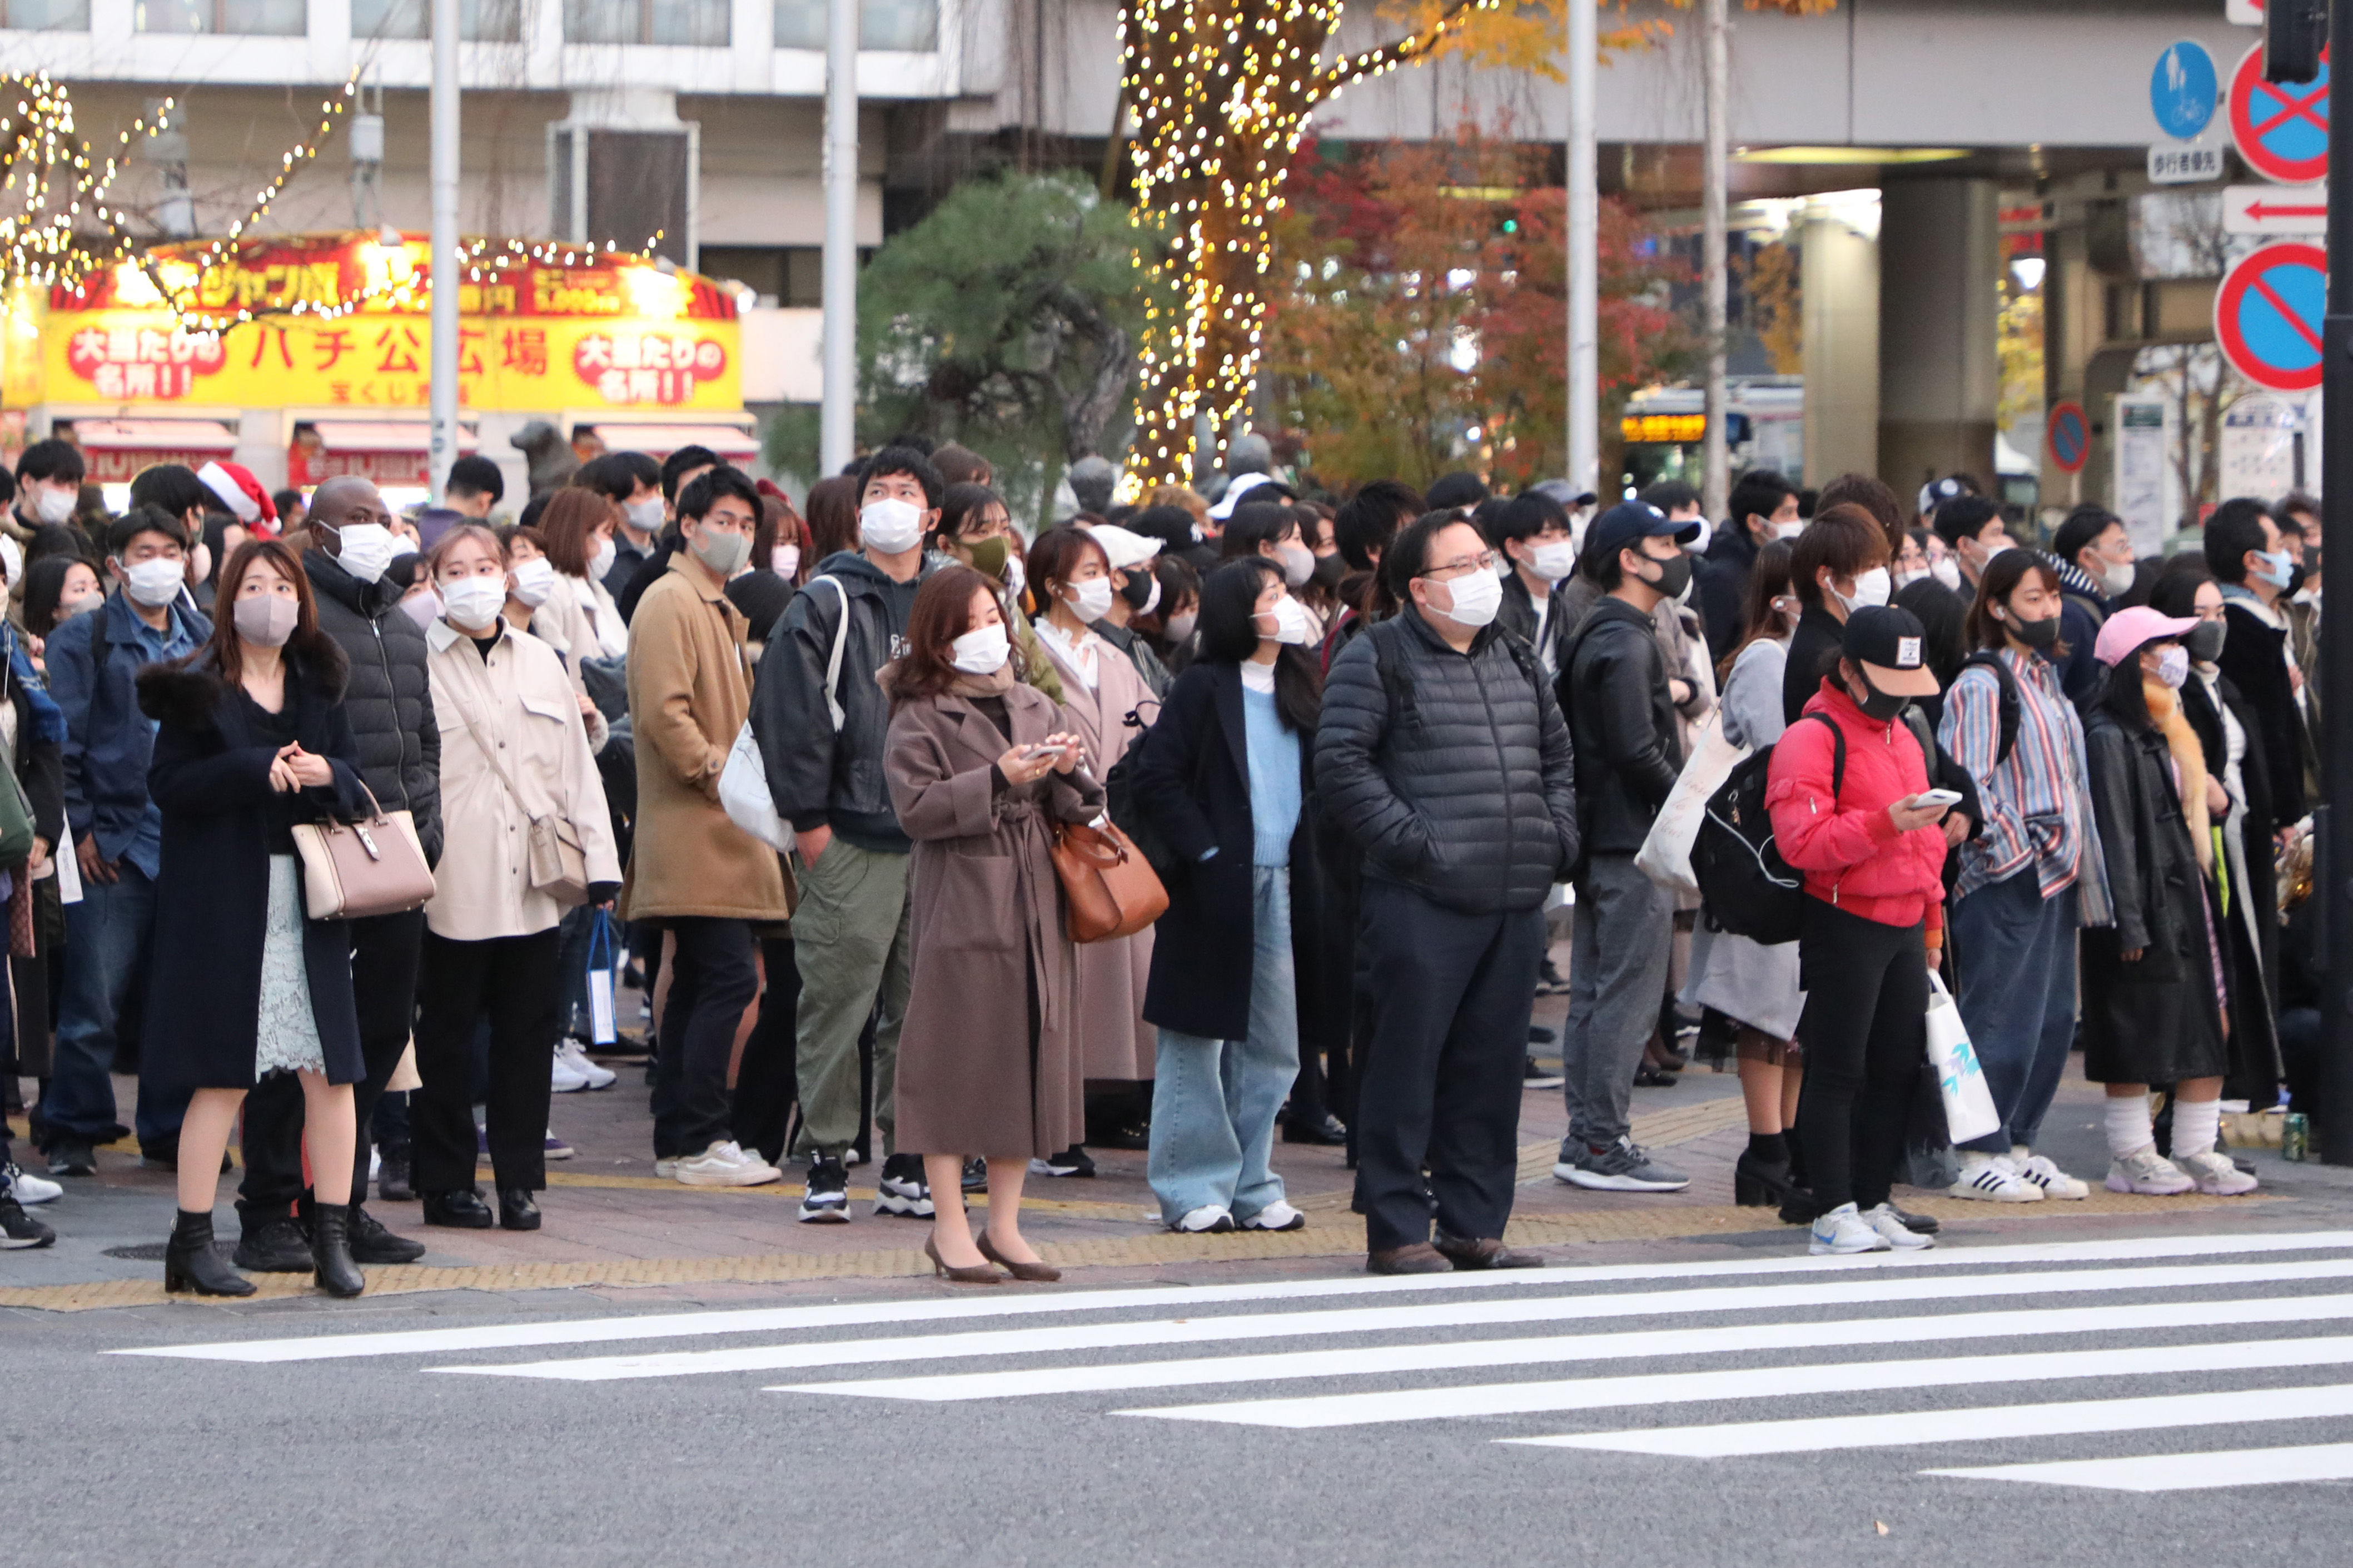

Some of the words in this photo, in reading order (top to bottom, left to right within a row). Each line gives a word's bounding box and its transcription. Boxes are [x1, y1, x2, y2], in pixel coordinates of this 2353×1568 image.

[74, 327, 221, 363] 大当たりの
[251, 327, 548, 376] ハチ公広場
[578, 334, 722, 369] 大当たりの
